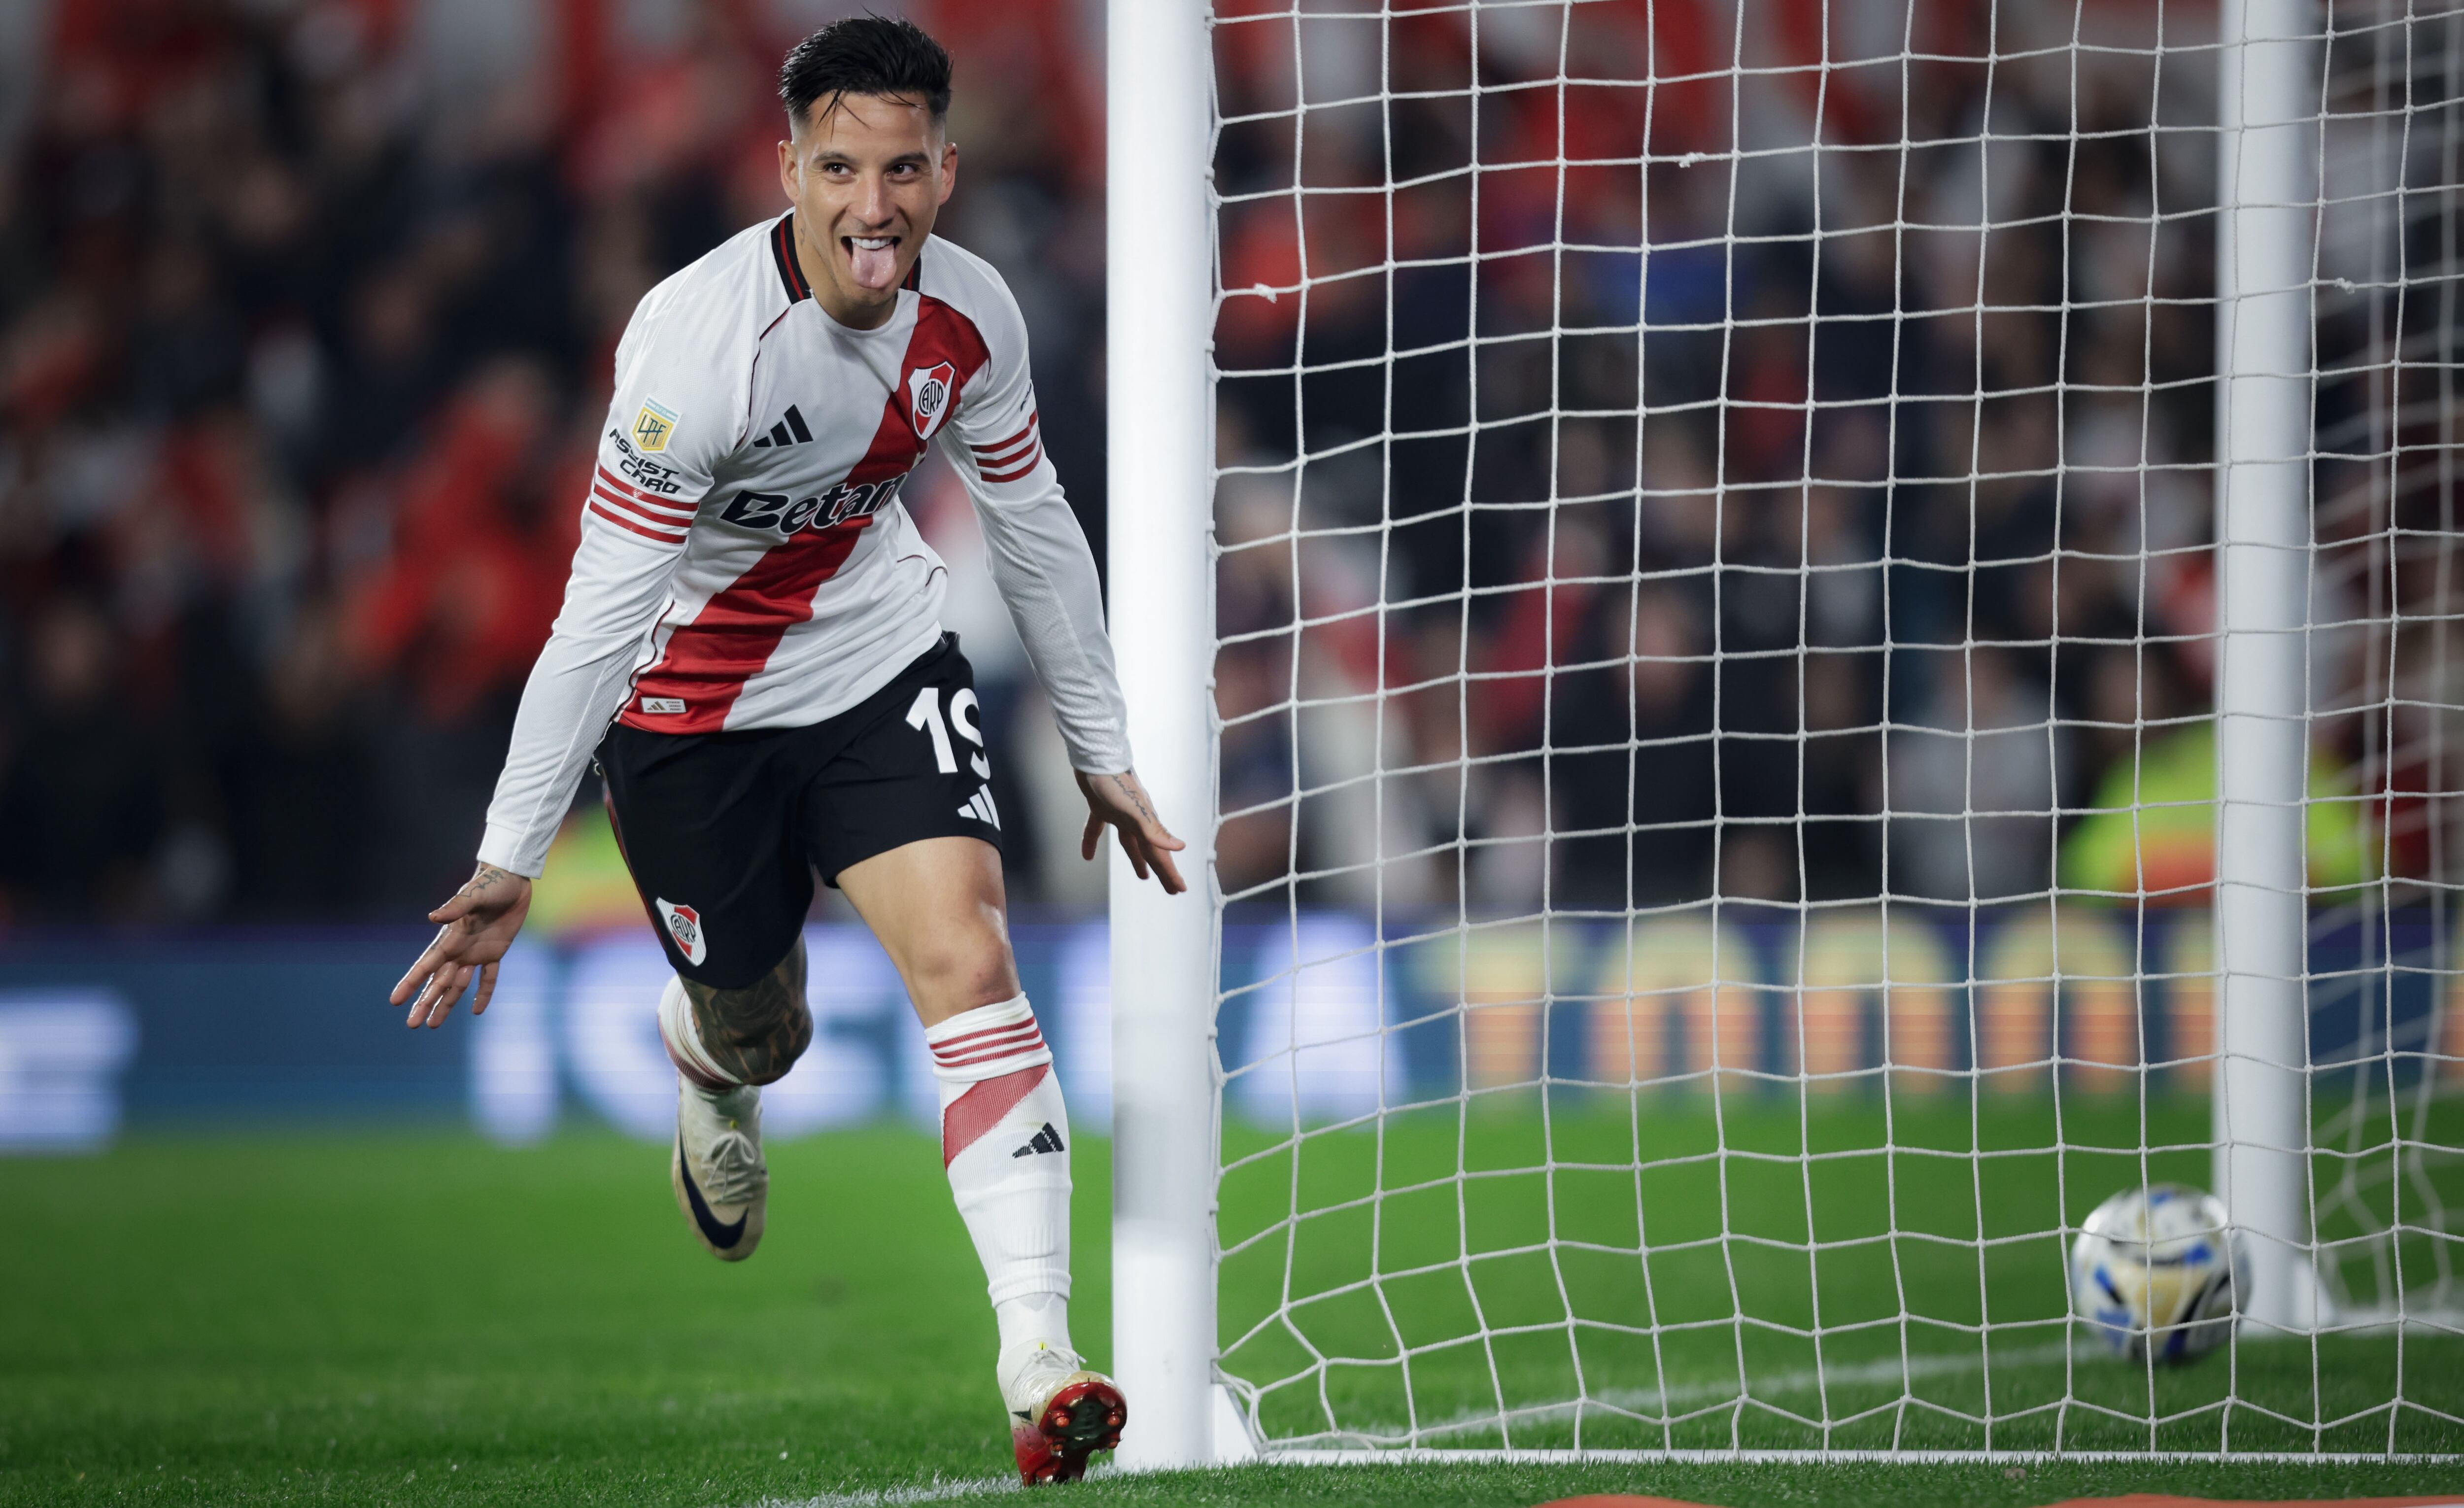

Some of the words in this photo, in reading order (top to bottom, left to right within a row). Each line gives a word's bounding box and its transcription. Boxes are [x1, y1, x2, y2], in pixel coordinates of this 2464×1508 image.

[619, 459, 681, 494] CARD
[717, 472, 908, 535] Betan
[905, 687, 991, 780] 19
